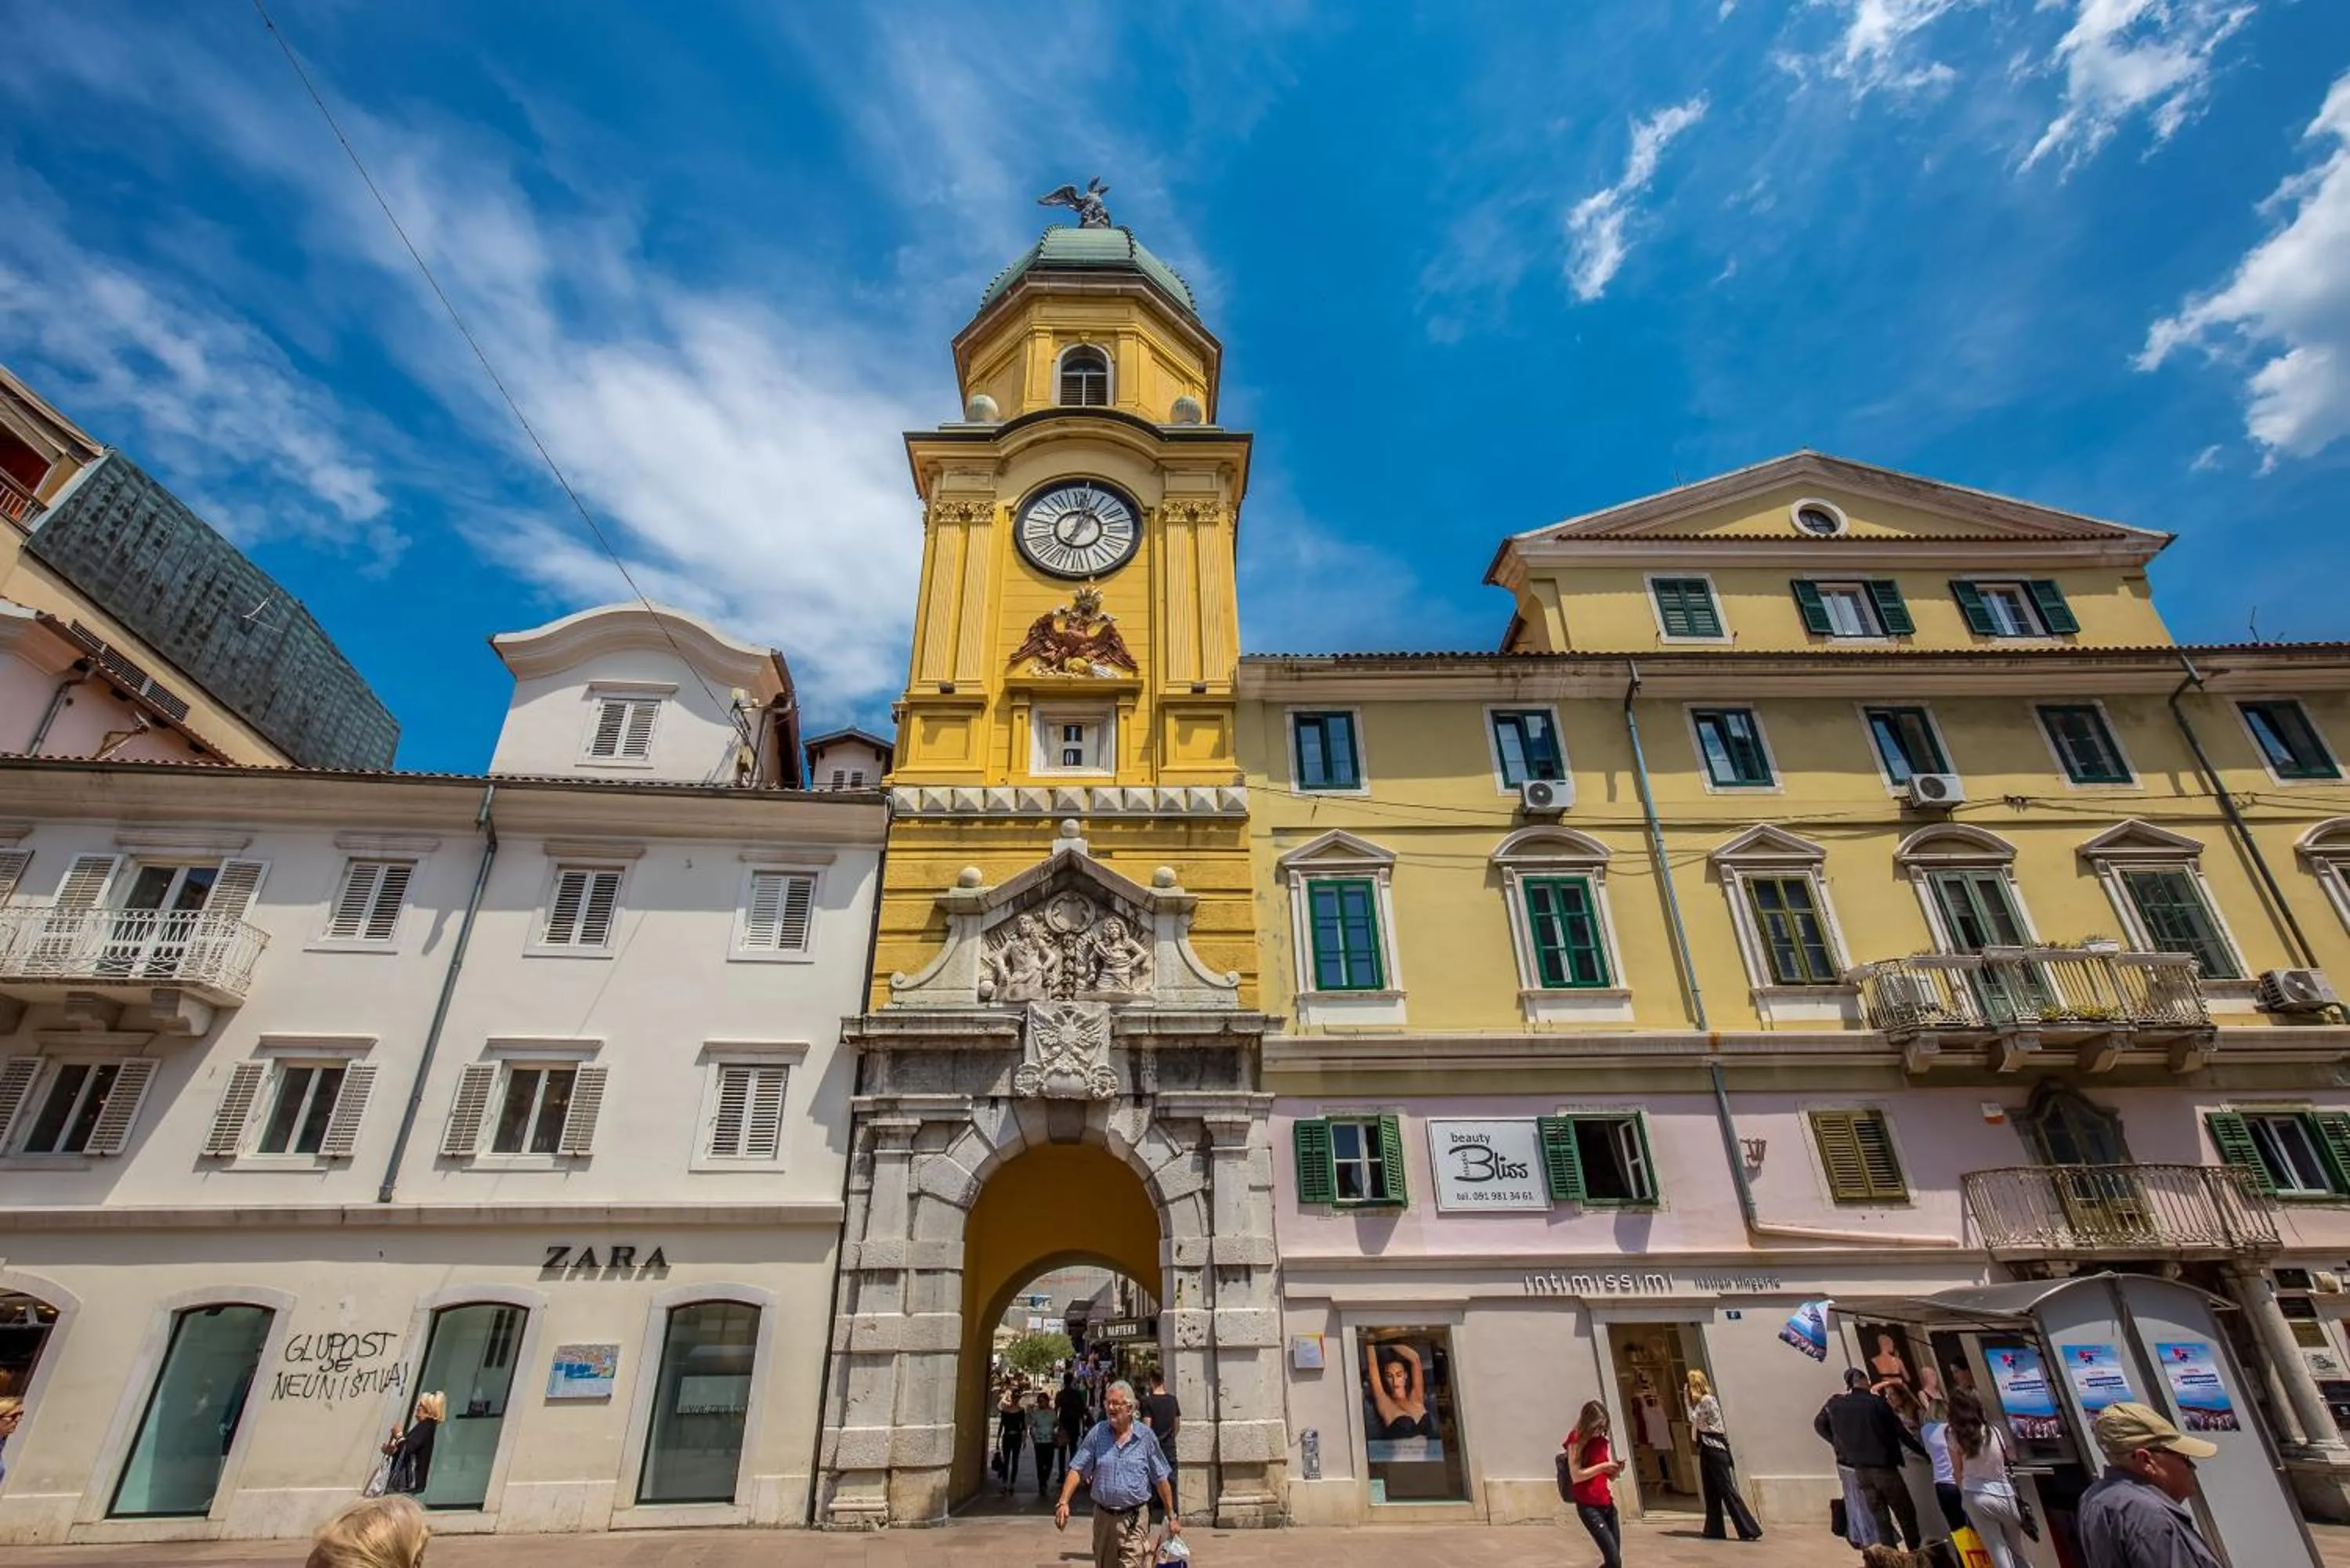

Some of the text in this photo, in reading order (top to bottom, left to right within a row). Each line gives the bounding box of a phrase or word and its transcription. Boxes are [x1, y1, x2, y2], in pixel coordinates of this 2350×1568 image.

[1451, 1133, 1491, 1144] beauty
[1448, 1144, 1528, 1182] Bliss
[1456, 1191, 1472, 1201] tel.
[542, 1246, 671, 1268] ZARA
[1524, 1272, 1675, 1292] intimissimi
[285, 1332, 397, 1362] GLUPOST
[320, 1357, 353, 1372] JE
